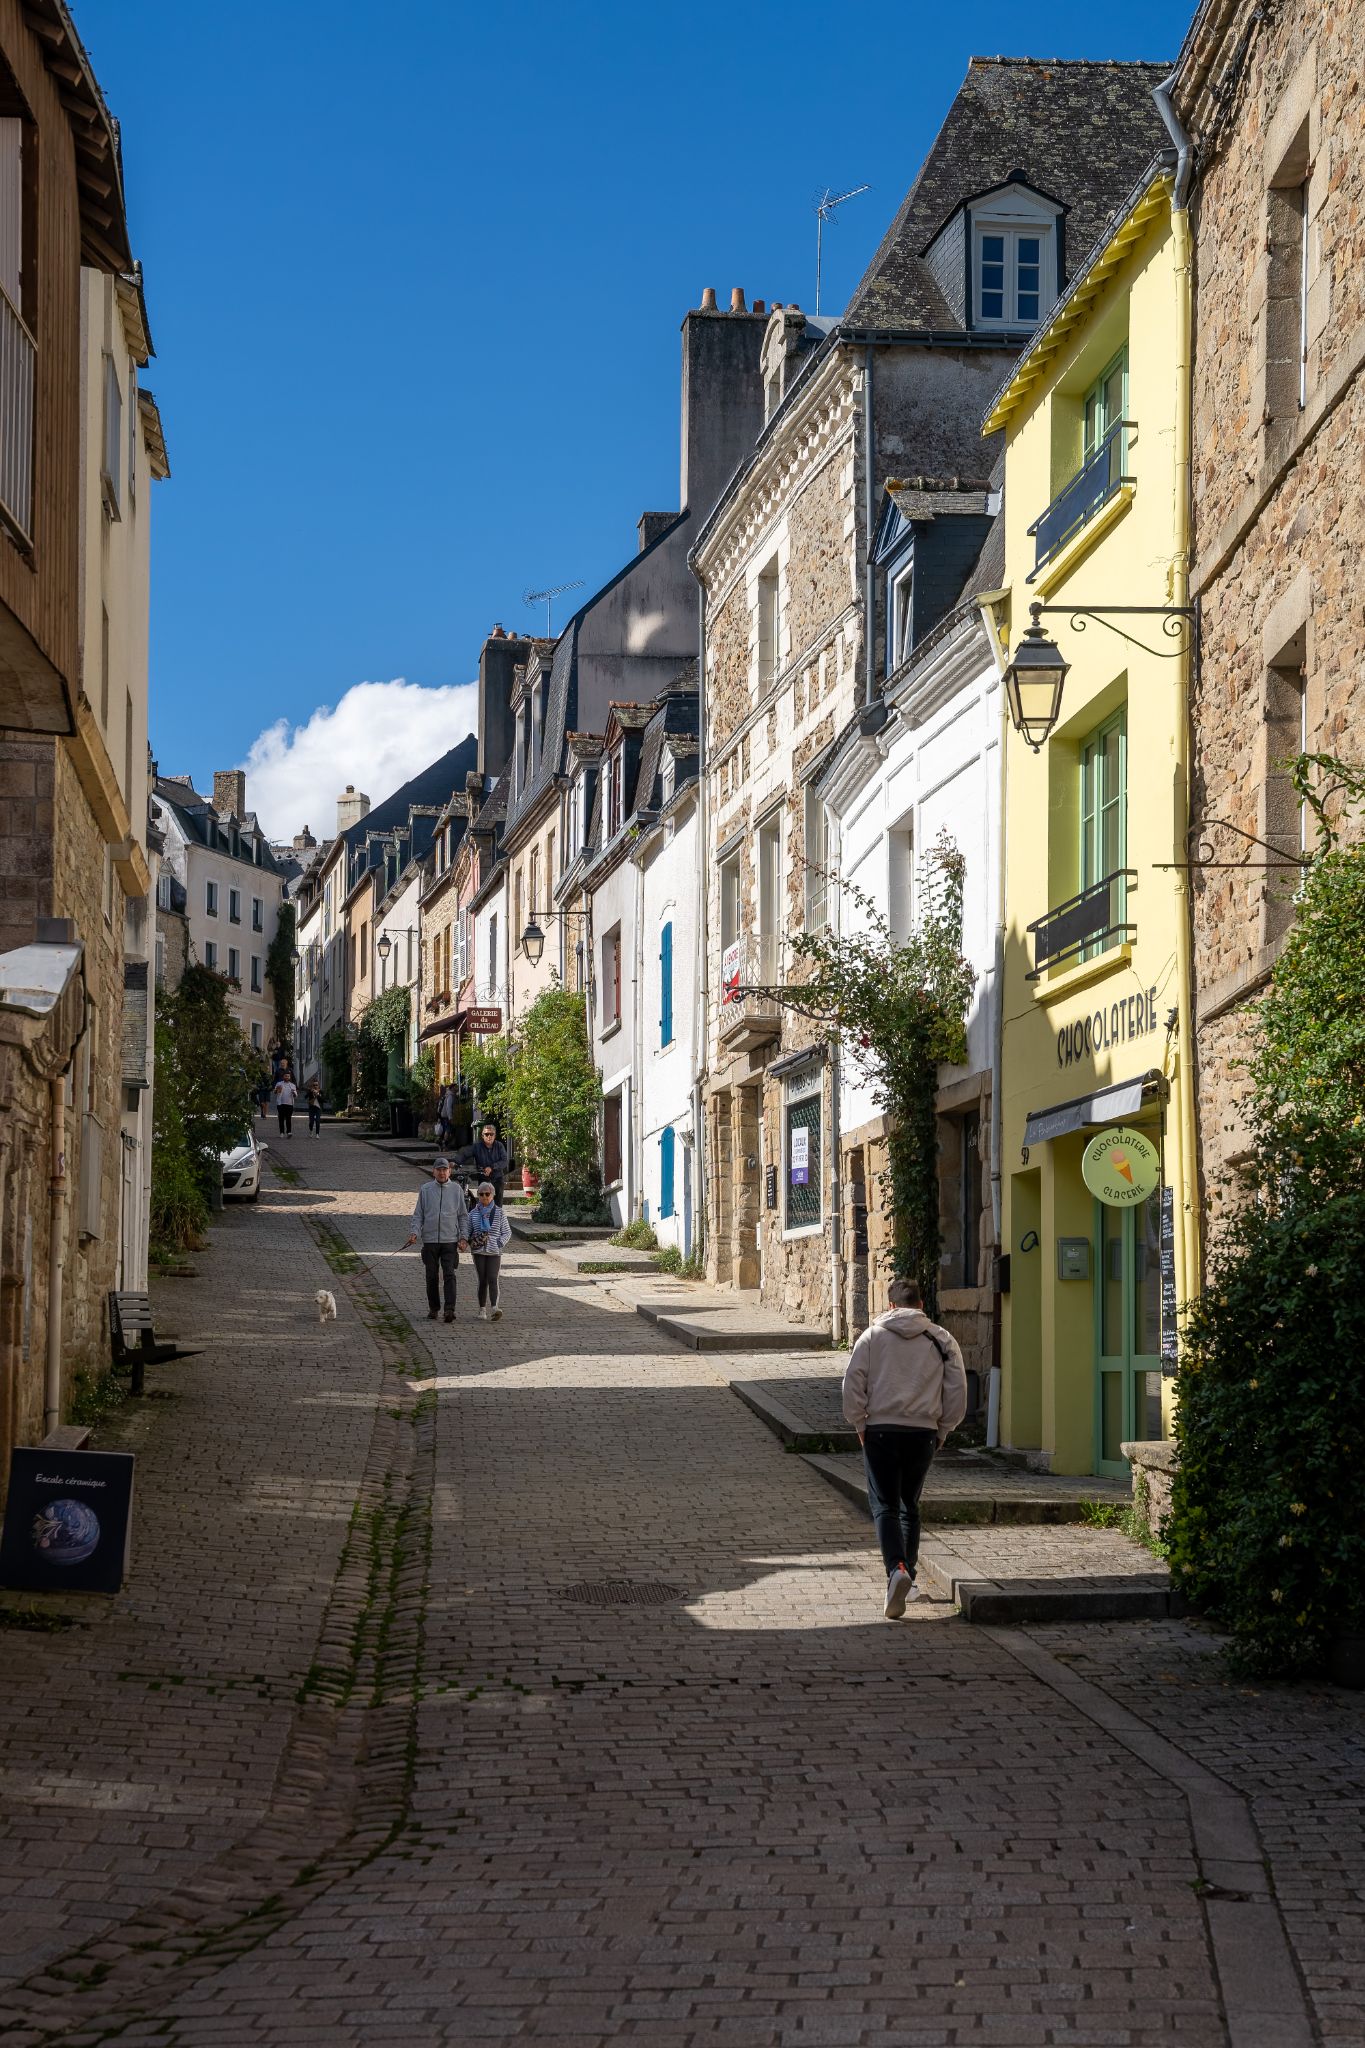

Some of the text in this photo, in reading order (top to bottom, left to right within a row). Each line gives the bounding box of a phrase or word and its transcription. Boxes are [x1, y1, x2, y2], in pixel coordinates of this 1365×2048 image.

[1058, 986, 1156, 1067] CHOCOLATERIE
[1092, 1135, 1150, 1161] CHOCOLATERIE
[1103, 1184, 1145, 1199] GLACERIE
[35, 1473, 106, 1488] Escale céramique
